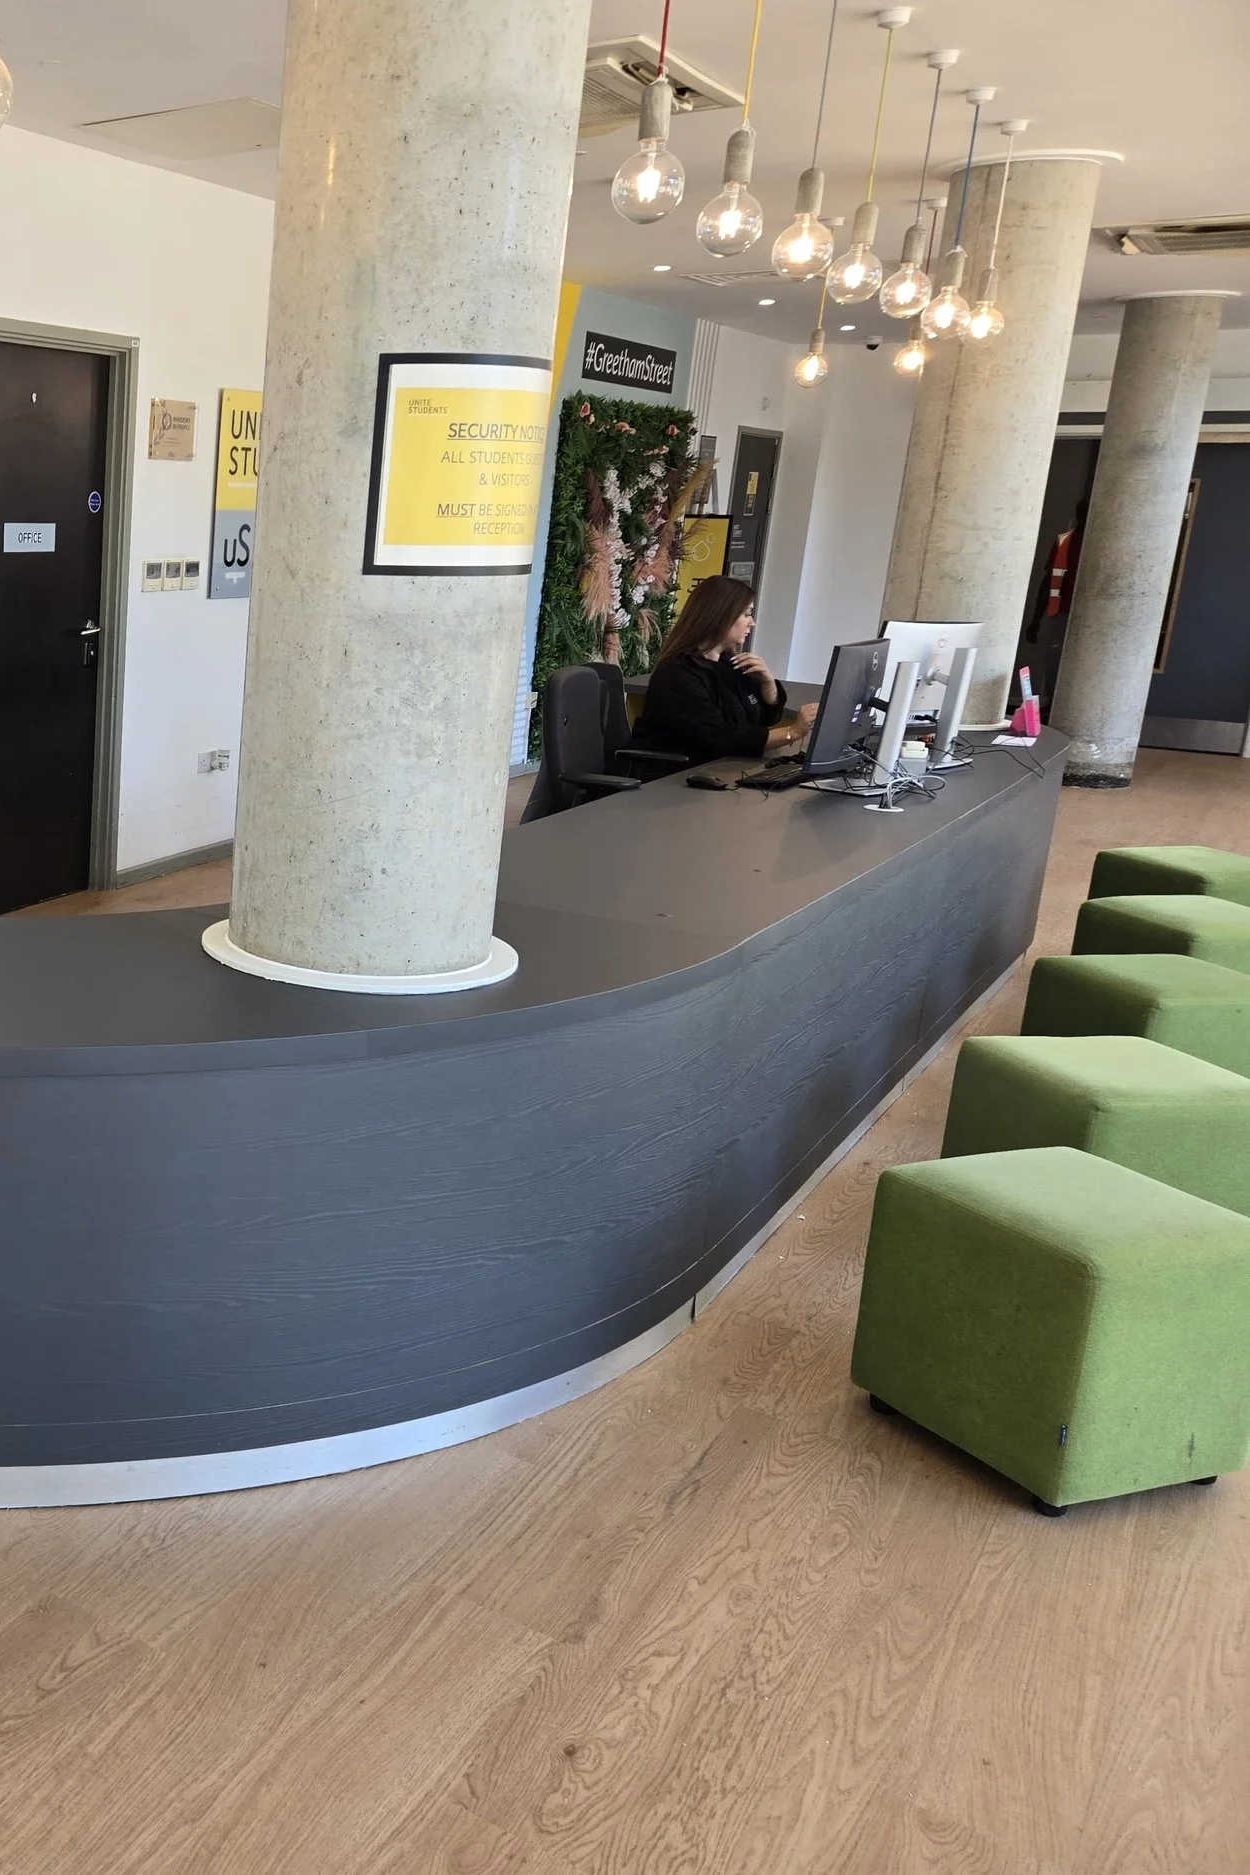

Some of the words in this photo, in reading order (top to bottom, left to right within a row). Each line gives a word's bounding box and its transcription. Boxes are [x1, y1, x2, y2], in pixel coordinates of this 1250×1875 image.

[584, 341, 673, 385] #GreethamStreet
[408, 399, 431, 407] UNITE
[408, 406, 448, 414] STUDENTS
[231, 409, 258, 440] UN
[448, 422, 520, 440] SECURITY
[440, 451, 466, 464] ALL
[469, 451, 525, 465] STUDENTS
[478, 472, 488, 486] &
[491, 473, 530, 487] VISITORS
[437, 503, 477, 516] MUST
[478, 503, 494, 516] BE
[494, 504, 527, 517] SIGNED
[473, 522, 525, 535] RECEPTION
[18, 532, 42, 543] OFFICE
